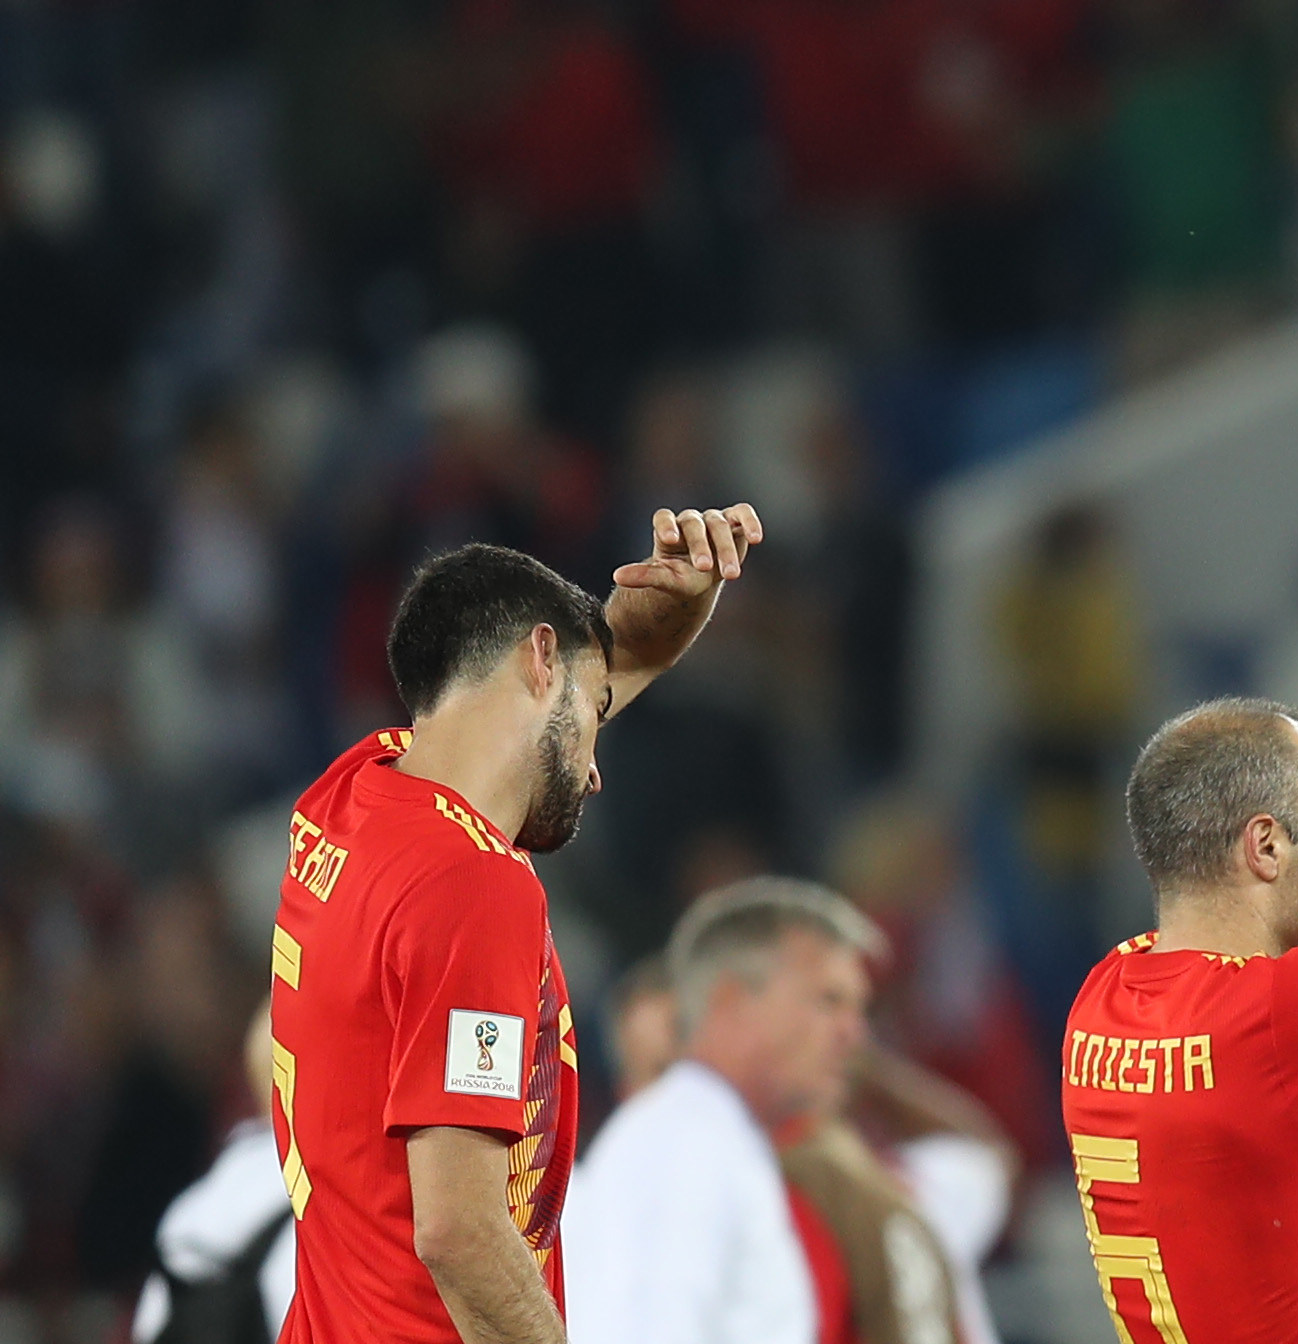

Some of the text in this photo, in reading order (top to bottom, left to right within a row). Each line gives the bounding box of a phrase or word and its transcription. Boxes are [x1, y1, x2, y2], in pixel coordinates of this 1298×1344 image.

[1069, 1029, 1215, 1094] INIESTA
[451, 1078, 515, 1093] RUSSIA 2018
